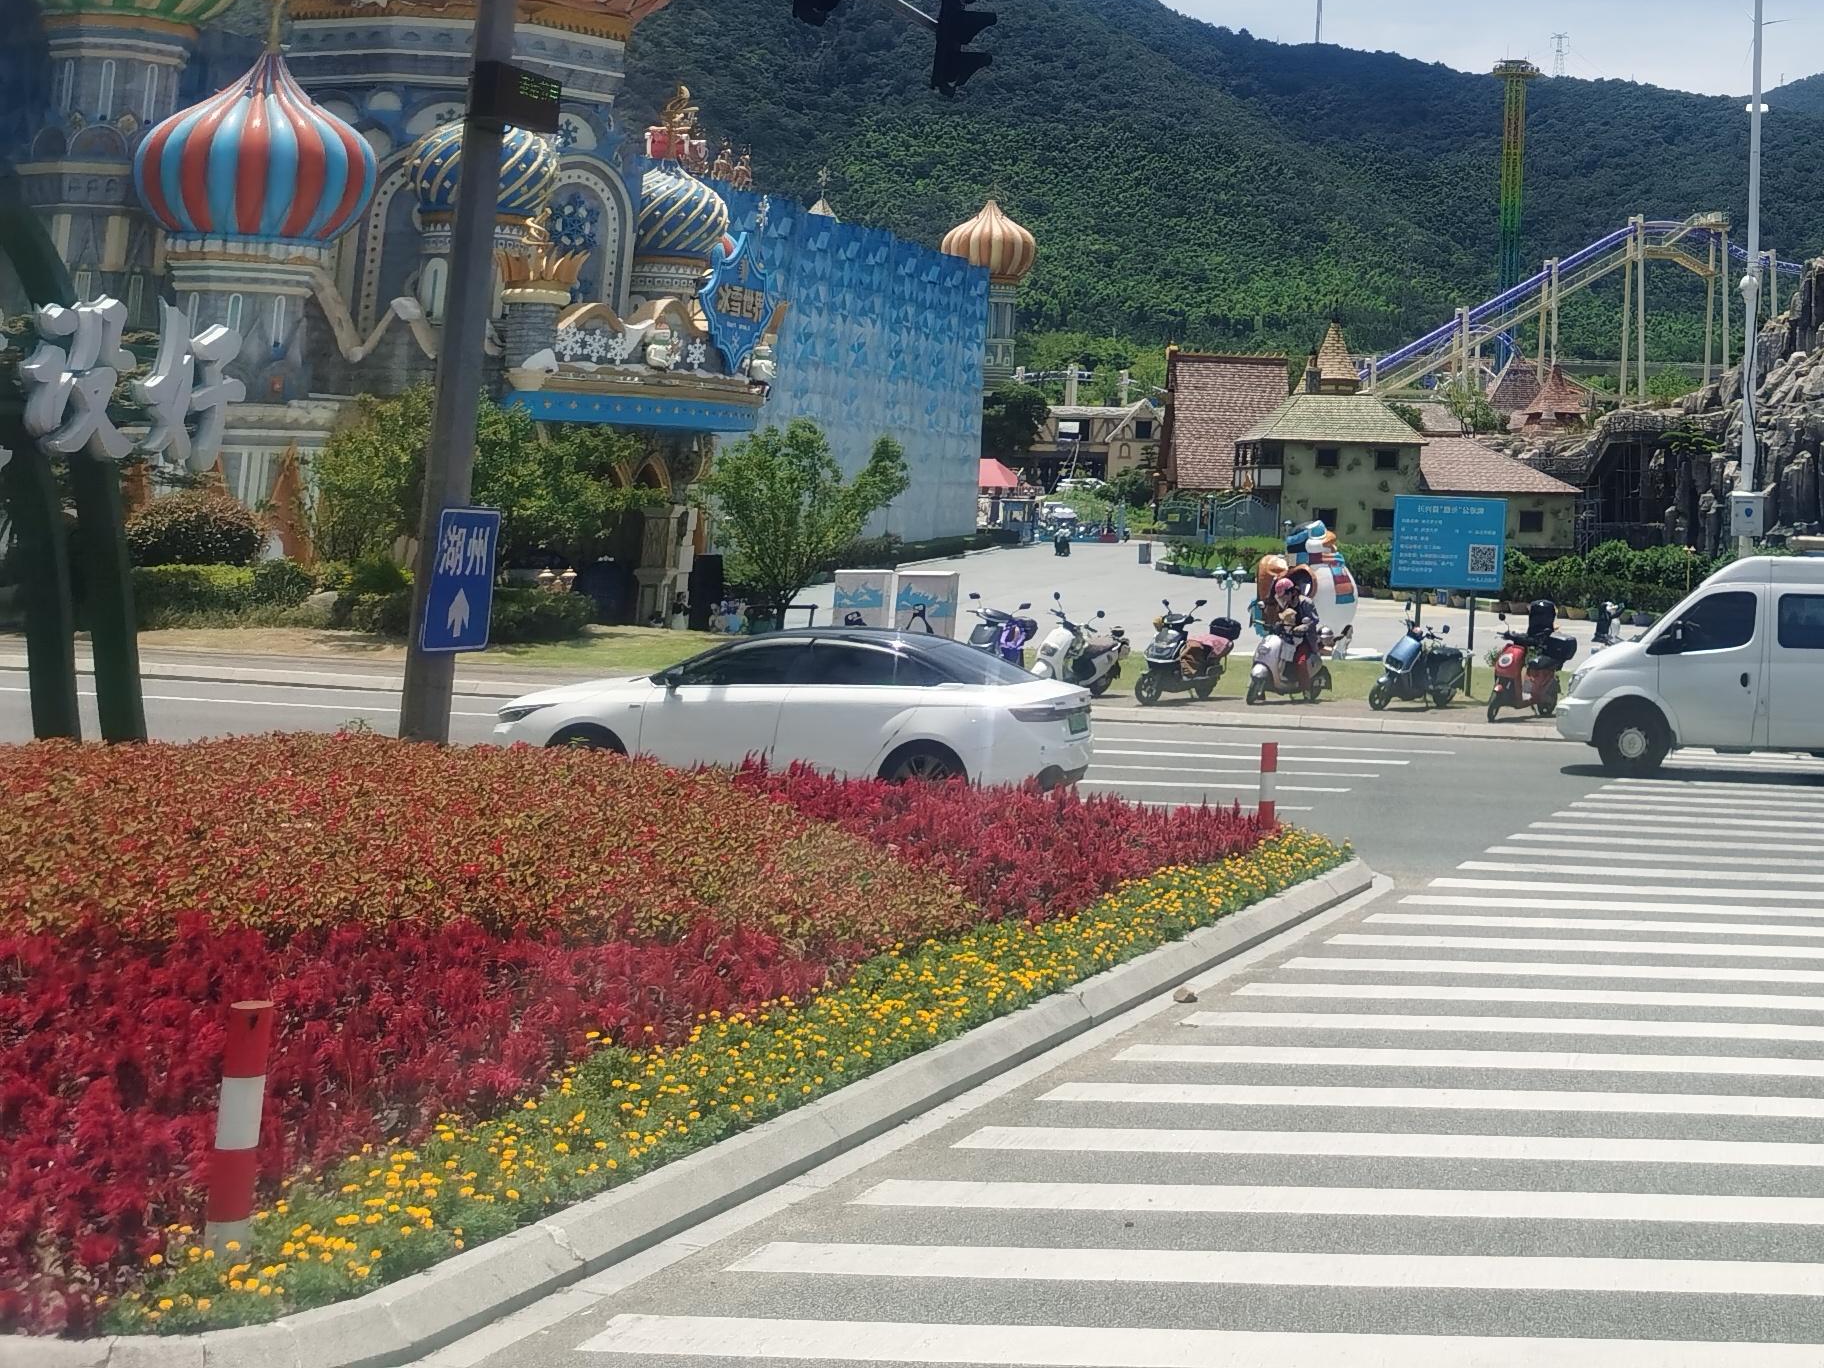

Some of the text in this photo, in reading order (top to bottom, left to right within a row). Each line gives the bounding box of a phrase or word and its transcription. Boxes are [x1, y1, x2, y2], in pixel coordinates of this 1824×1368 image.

[717, 284, 765, 323] 冰雪世界
[0, 294, 246, 473] 设好
[439, 525, 491, 576] 湖州
